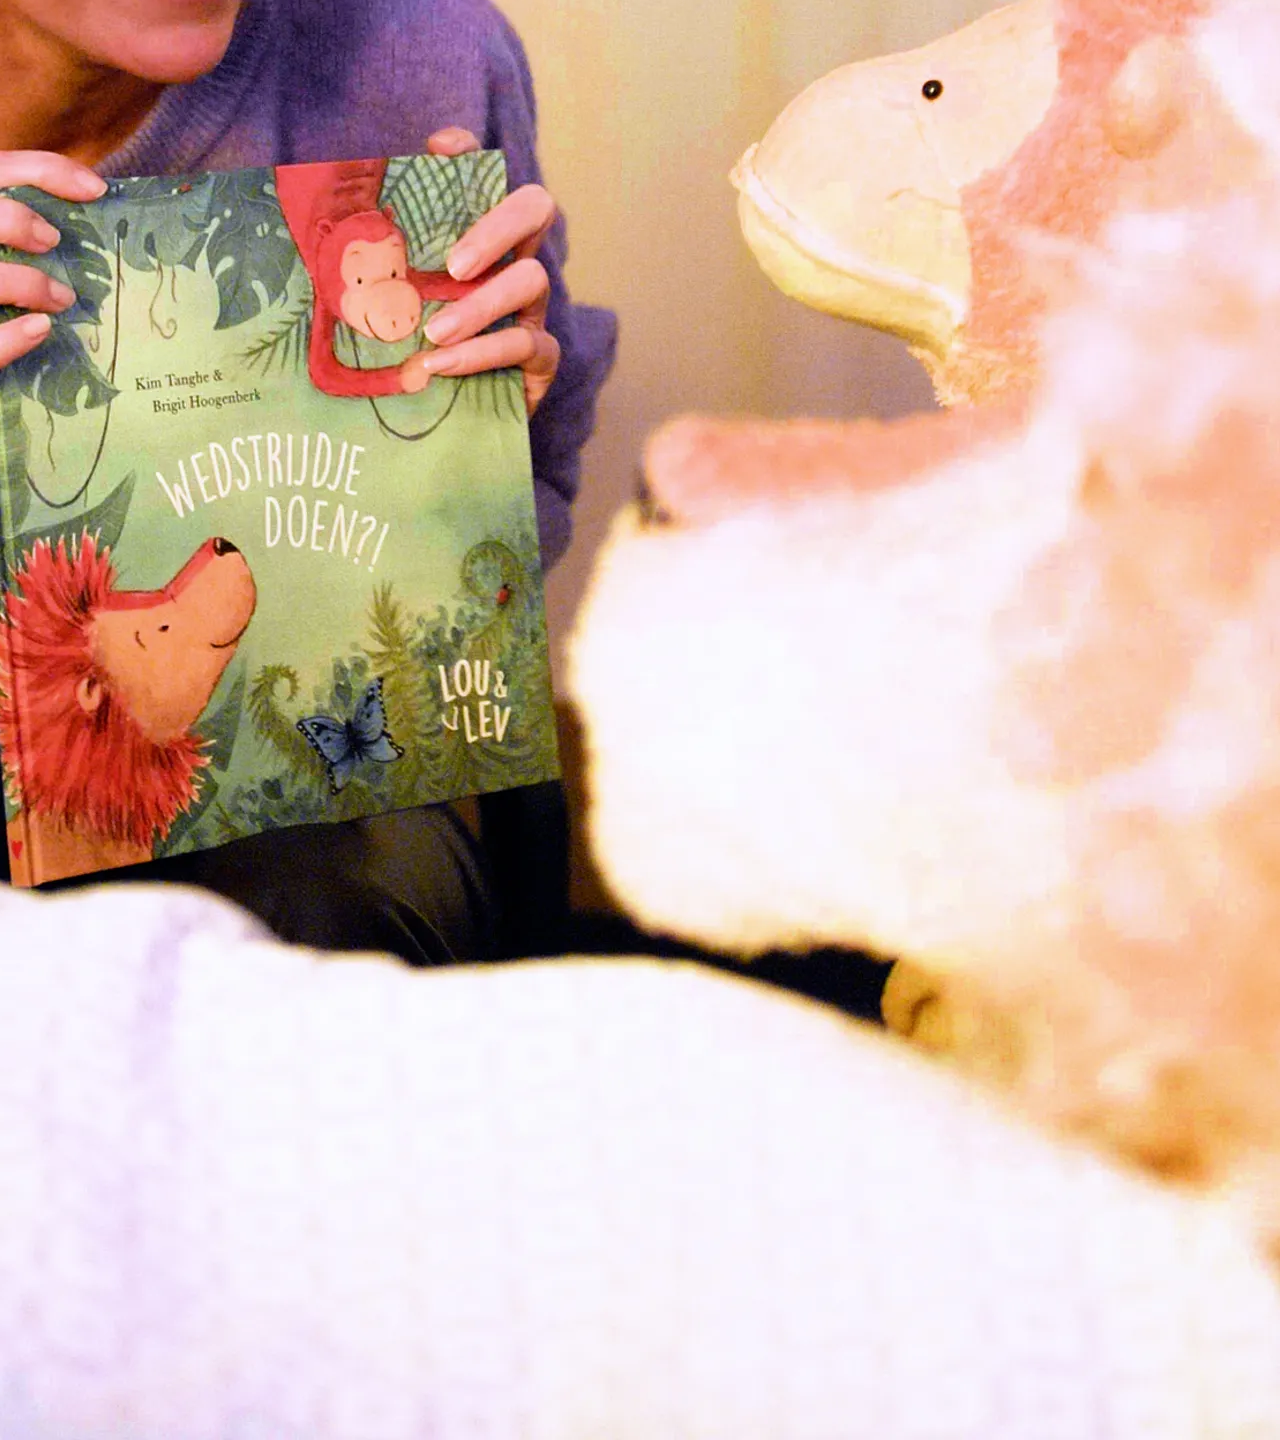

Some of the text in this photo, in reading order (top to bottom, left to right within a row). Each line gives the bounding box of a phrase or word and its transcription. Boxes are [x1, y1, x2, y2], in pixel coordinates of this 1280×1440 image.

[134, 369, 223, 391] Kim Tanghe &
[152, 388, 261, 415] Brigit Hoogenberk
[156, 432, 365, 519] WEDSTRIJDJE
[265, 495, 389, 573] DOEN?!
[438, 659, 508, 702] LOU &
[463, 700, 511, 744] LEV
